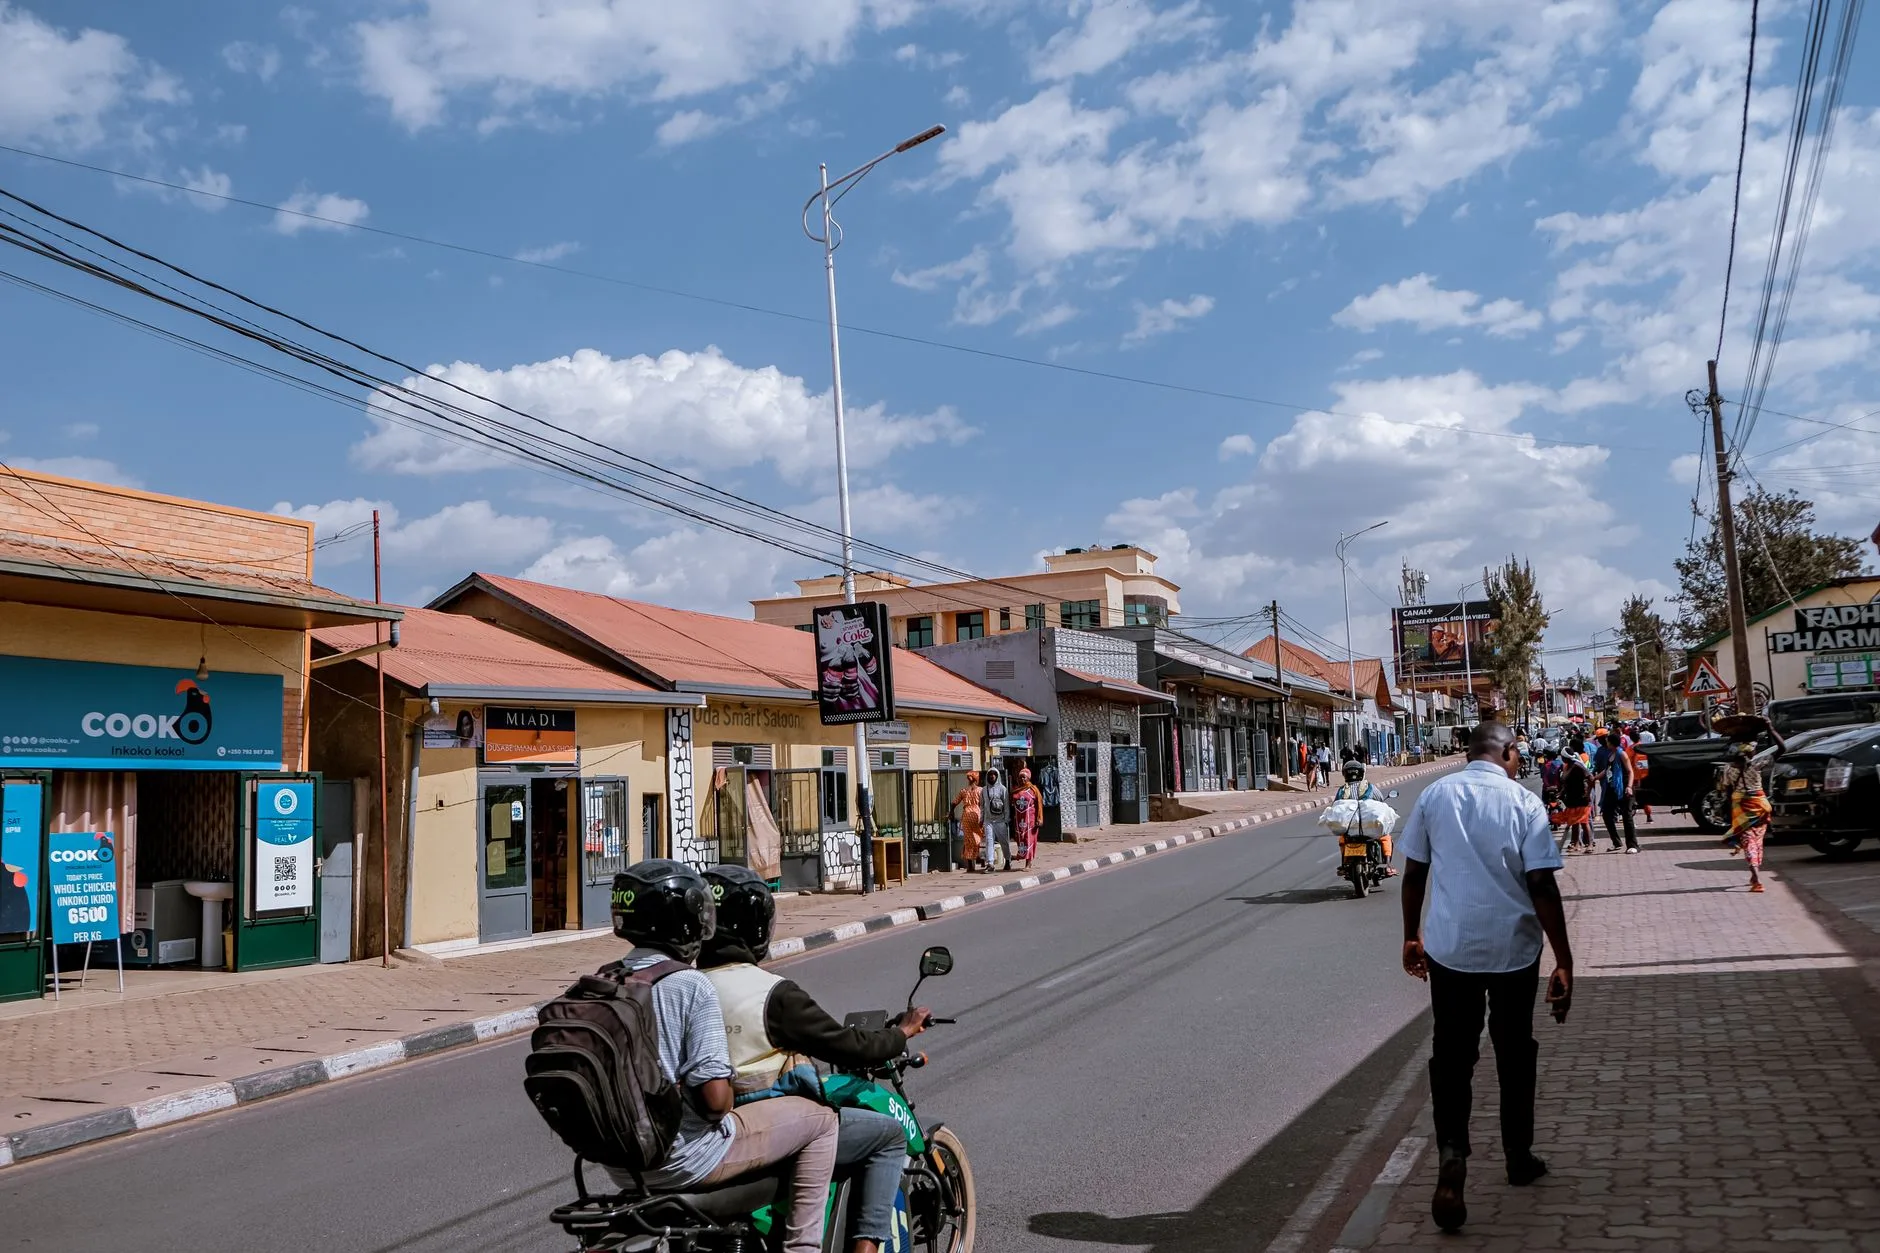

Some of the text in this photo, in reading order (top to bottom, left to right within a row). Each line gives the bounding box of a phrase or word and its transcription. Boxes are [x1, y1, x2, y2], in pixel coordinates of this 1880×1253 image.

[1402, 608, 1433, 617] CANAL+
[843, 629, 870, 643] Coke
[506, 712, 556, 727] MIADI
[723, 704, 761, 726] Smart
[81, 711, 208, 741] COOKO
[111, 746, 185, 756] Inkoko koko!
[7, 817, 21, 825] SAT
[50, 848, 114, 863] COOKO
[66, 873, 87, 882] TODAY'S
[53, 881, 116, 894] WHOLE CHICKEN
[57, 893, 114, 907] (INKOKO IKIRO)
[68, 906, 108, 924] 6500
[73, 930, 102, 942] PER KG
[889, 1097, 917, 1140] spiro
